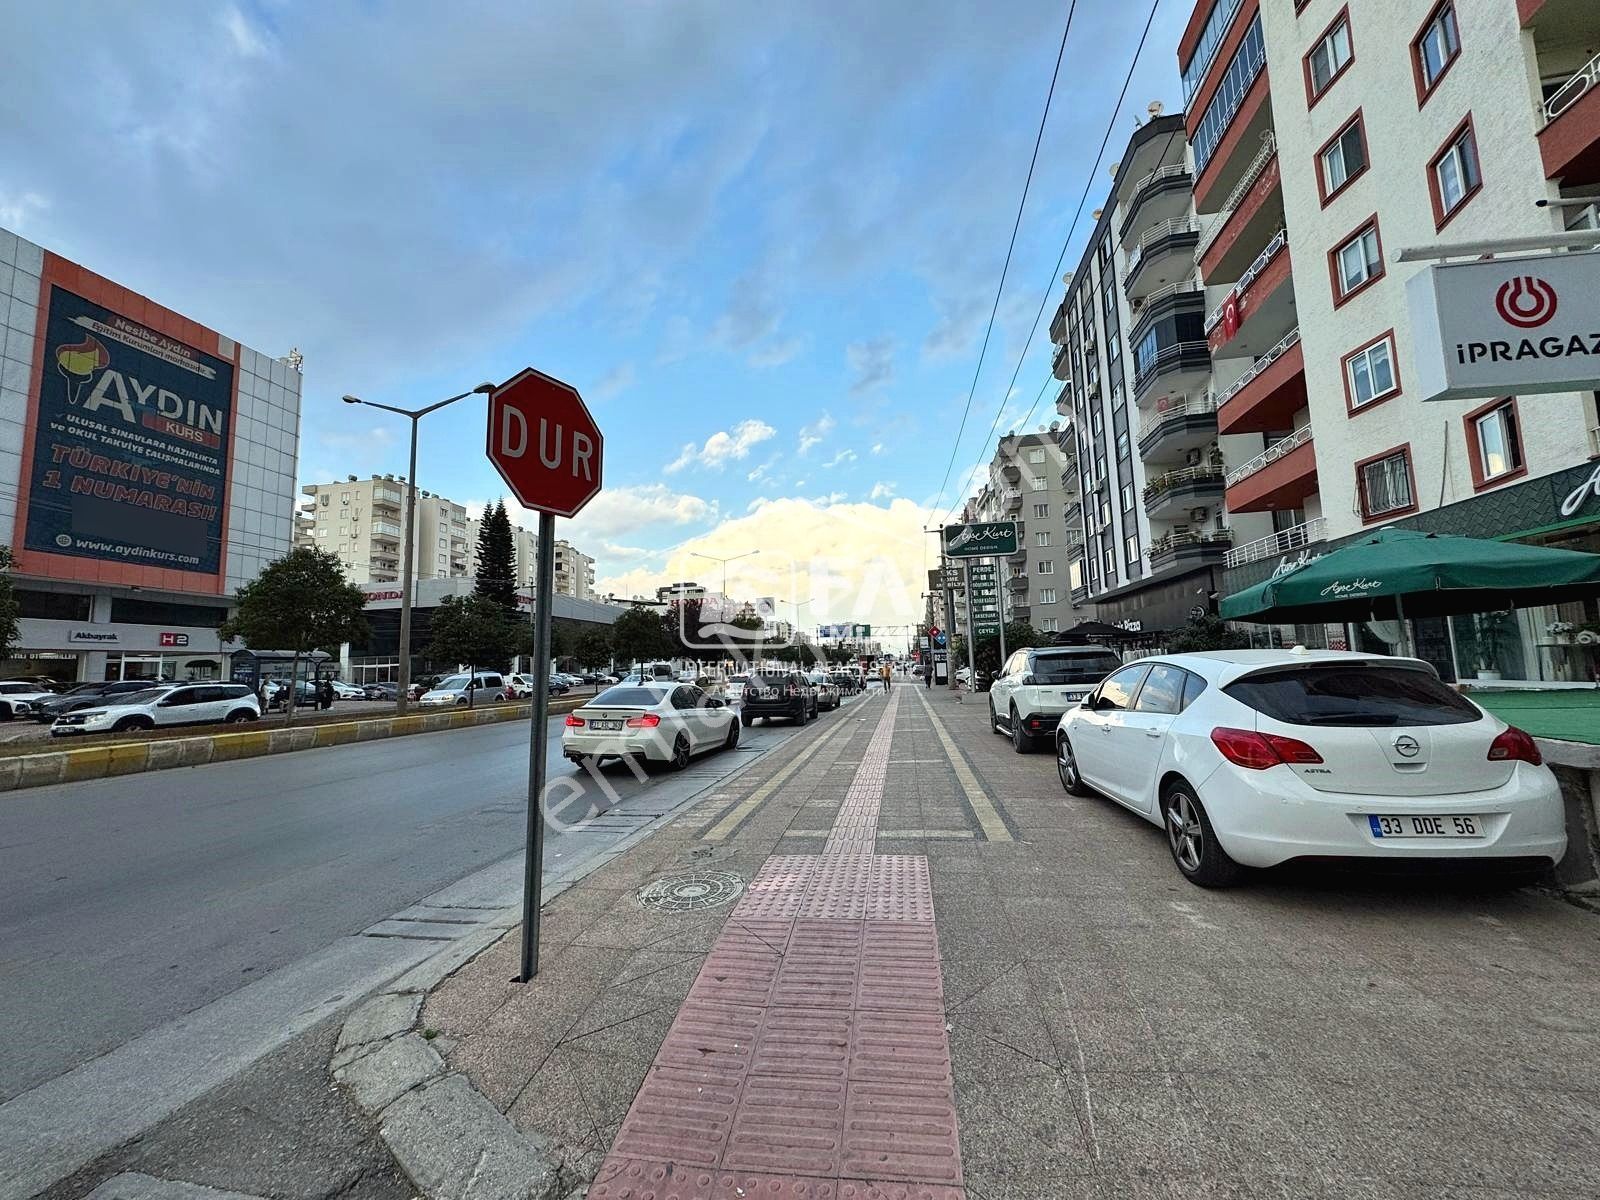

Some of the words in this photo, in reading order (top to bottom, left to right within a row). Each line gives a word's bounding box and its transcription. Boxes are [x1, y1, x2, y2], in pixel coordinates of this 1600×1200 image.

[114, 318, 158, 344] Nesibe
[82, 369, 223, 436] AYDIN
[66, 413, 108, 433] ULUSAL
[110, 427, 166, 450] SINAVLARA
[167, 444, 218, 465] HAZIRLIKTA
[165, 421, 204, 442] KURS
[502, 404, 592, 481] DUR
[50, 422, 66, 431] ve
[67, 426, 98, 441] OKUL
[100, 434, 144, 455] TAKVİYE
[145, 449, 221, 476] ÇALIŞMALARINDA
[42, 470, 62, 489] 1
[980, 526, 1014, 540] Kurt
[76, 538, 200, 565] www.aydinkurs.com
[74, 631, 118, 641] Akbayrak
[162, 633, 188, 645] H2
[1381, 817, 1404, 835] 33
[1413, 816, 1445, 835] DDE
[1455, 817, 1476, 835] 56
